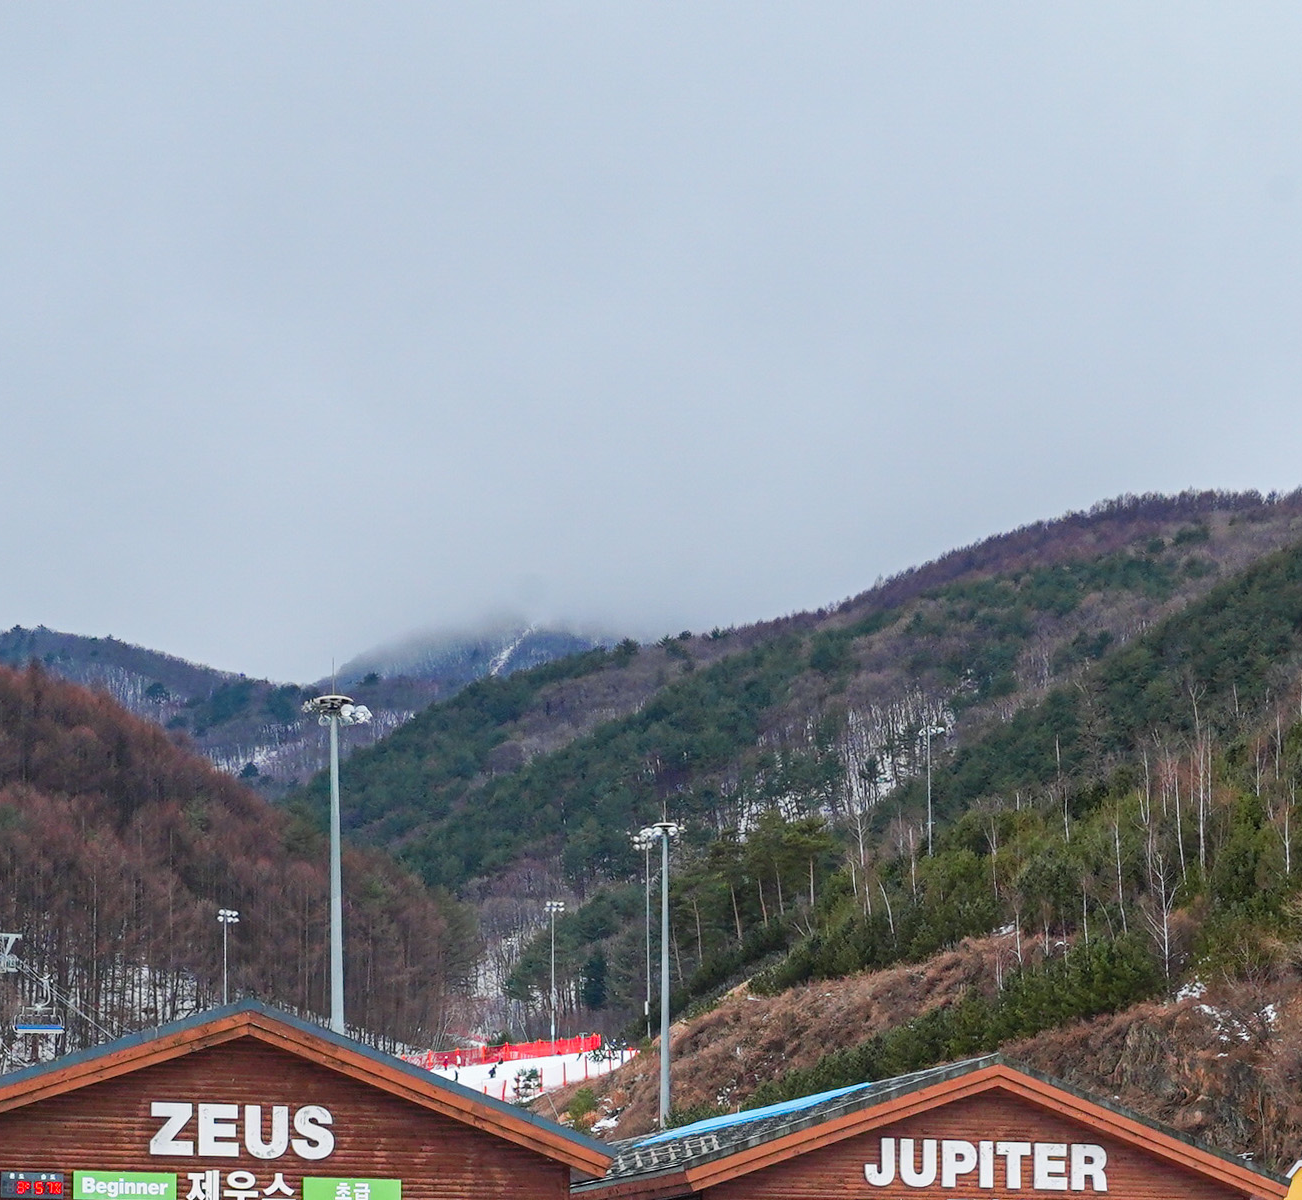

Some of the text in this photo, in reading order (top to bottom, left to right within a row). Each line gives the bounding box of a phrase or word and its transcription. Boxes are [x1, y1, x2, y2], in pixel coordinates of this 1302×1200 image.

[149, 1102, 335, 1160] ZEUS
[81, 1177, 168, 1197] Beginner
[864, 1137, 1109, 1192] JUPITER
